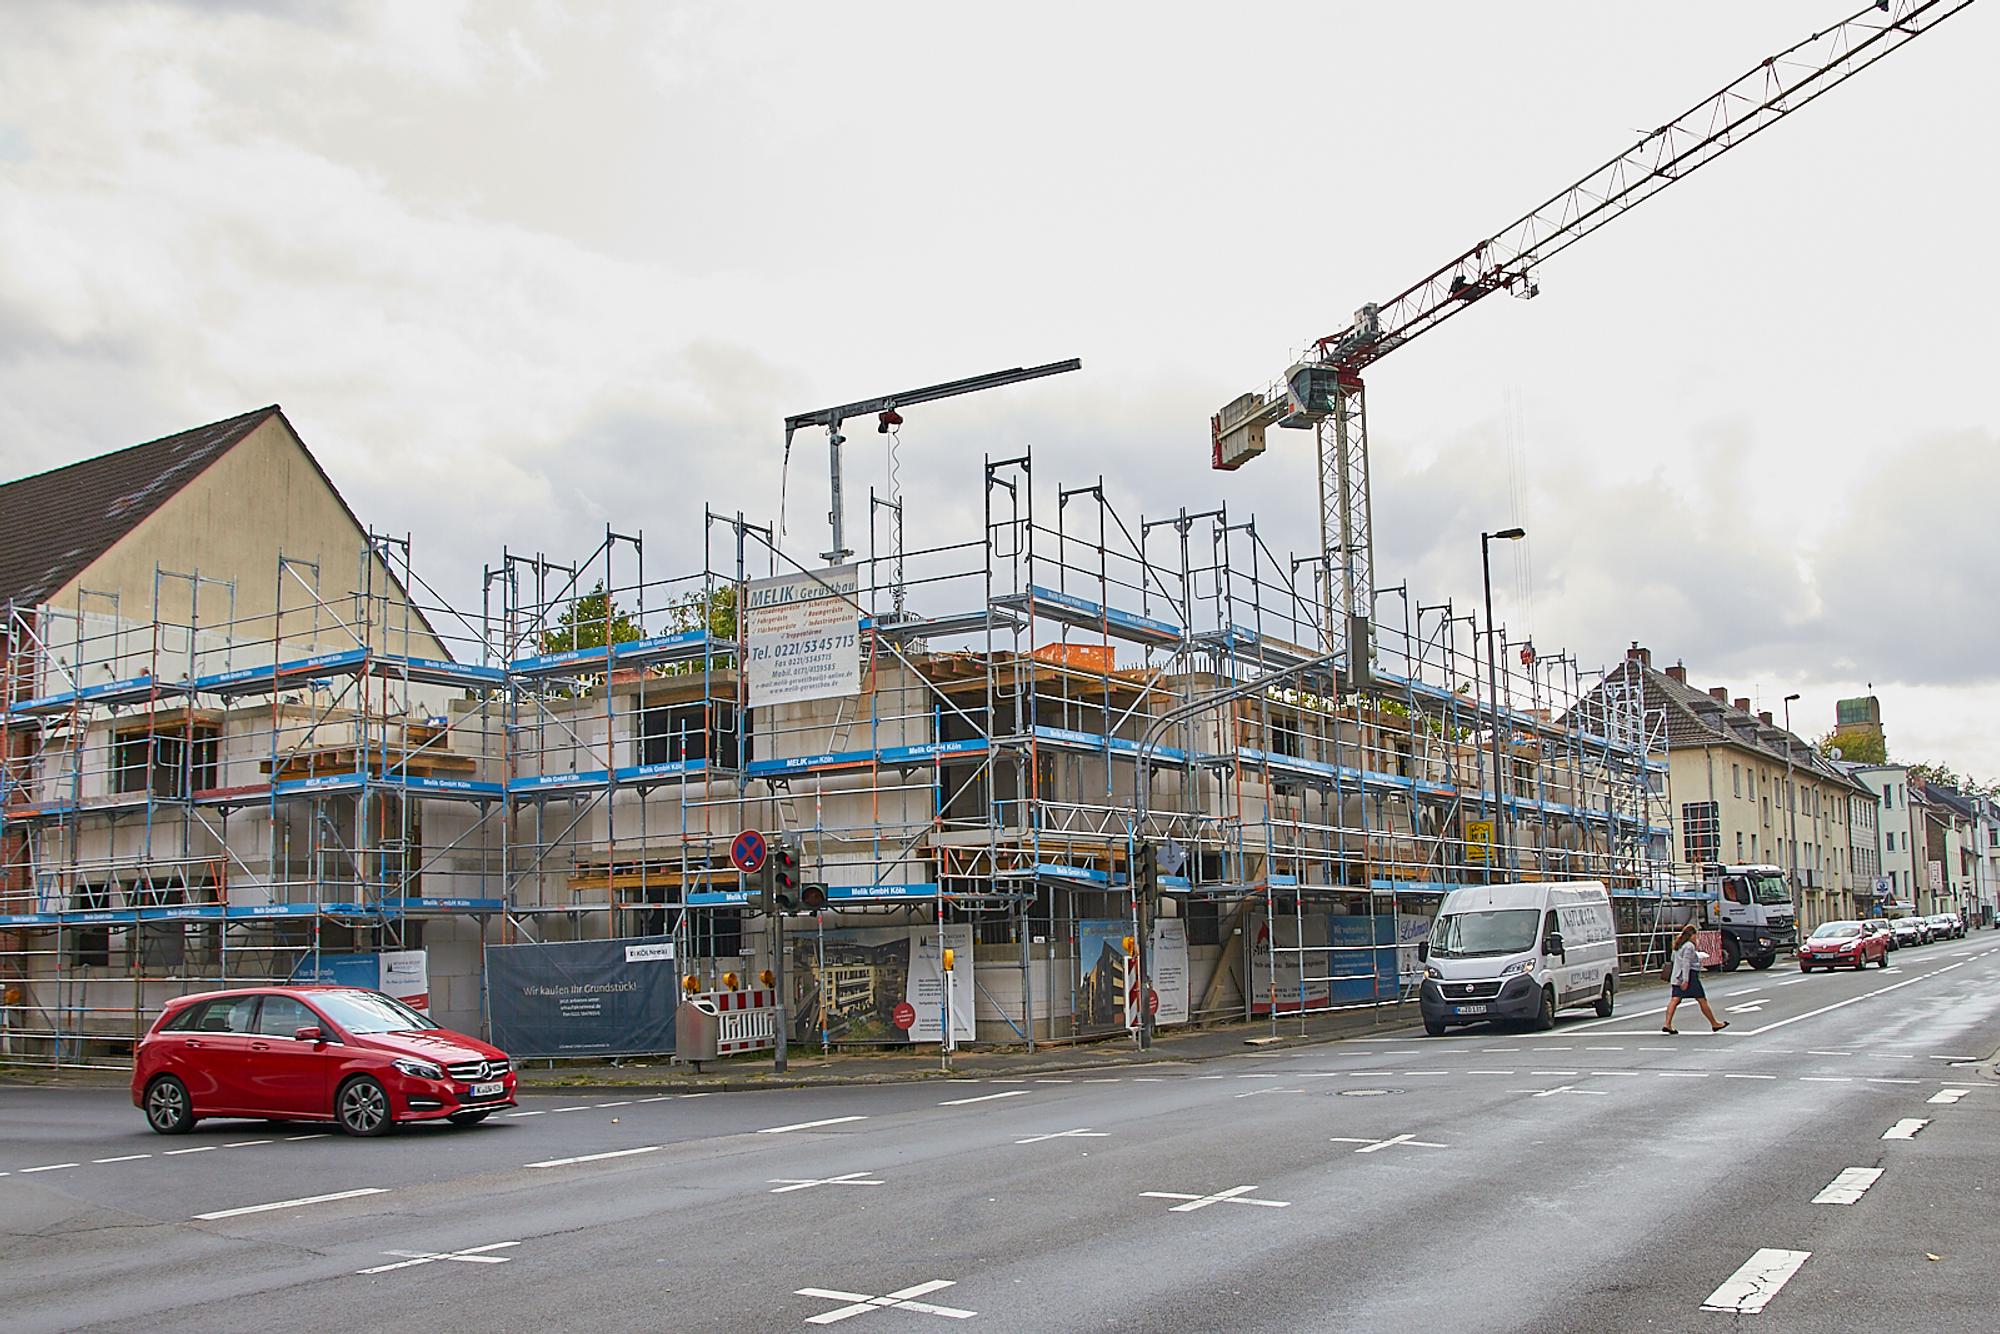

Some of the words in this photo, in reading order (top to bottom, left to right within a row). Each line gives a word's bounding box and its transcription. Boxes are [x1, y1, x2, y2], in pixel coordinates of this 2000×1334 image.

[750, 585, 794, 607] MELIK
[752, 645, 771, 661] Tel.
[835, 634, 855, 649] 713
[774, 660, 787, 668] Fax
[909, 747, 925, 755] Melik
[947, 742, 962, 751] Köln
[787, 758, 807, 767] MELIK
[820, 756, 834, 764] Köln
[869, 887, 889, 895] GmbH
[890, 886, 906, 895] Köln
[523, 985, 538, 996] Wir
[540, 985, 569, 996] kaufen
[571, 983, 583, 994] Ihr
[584, 980, 637, 993] Grundstück!
